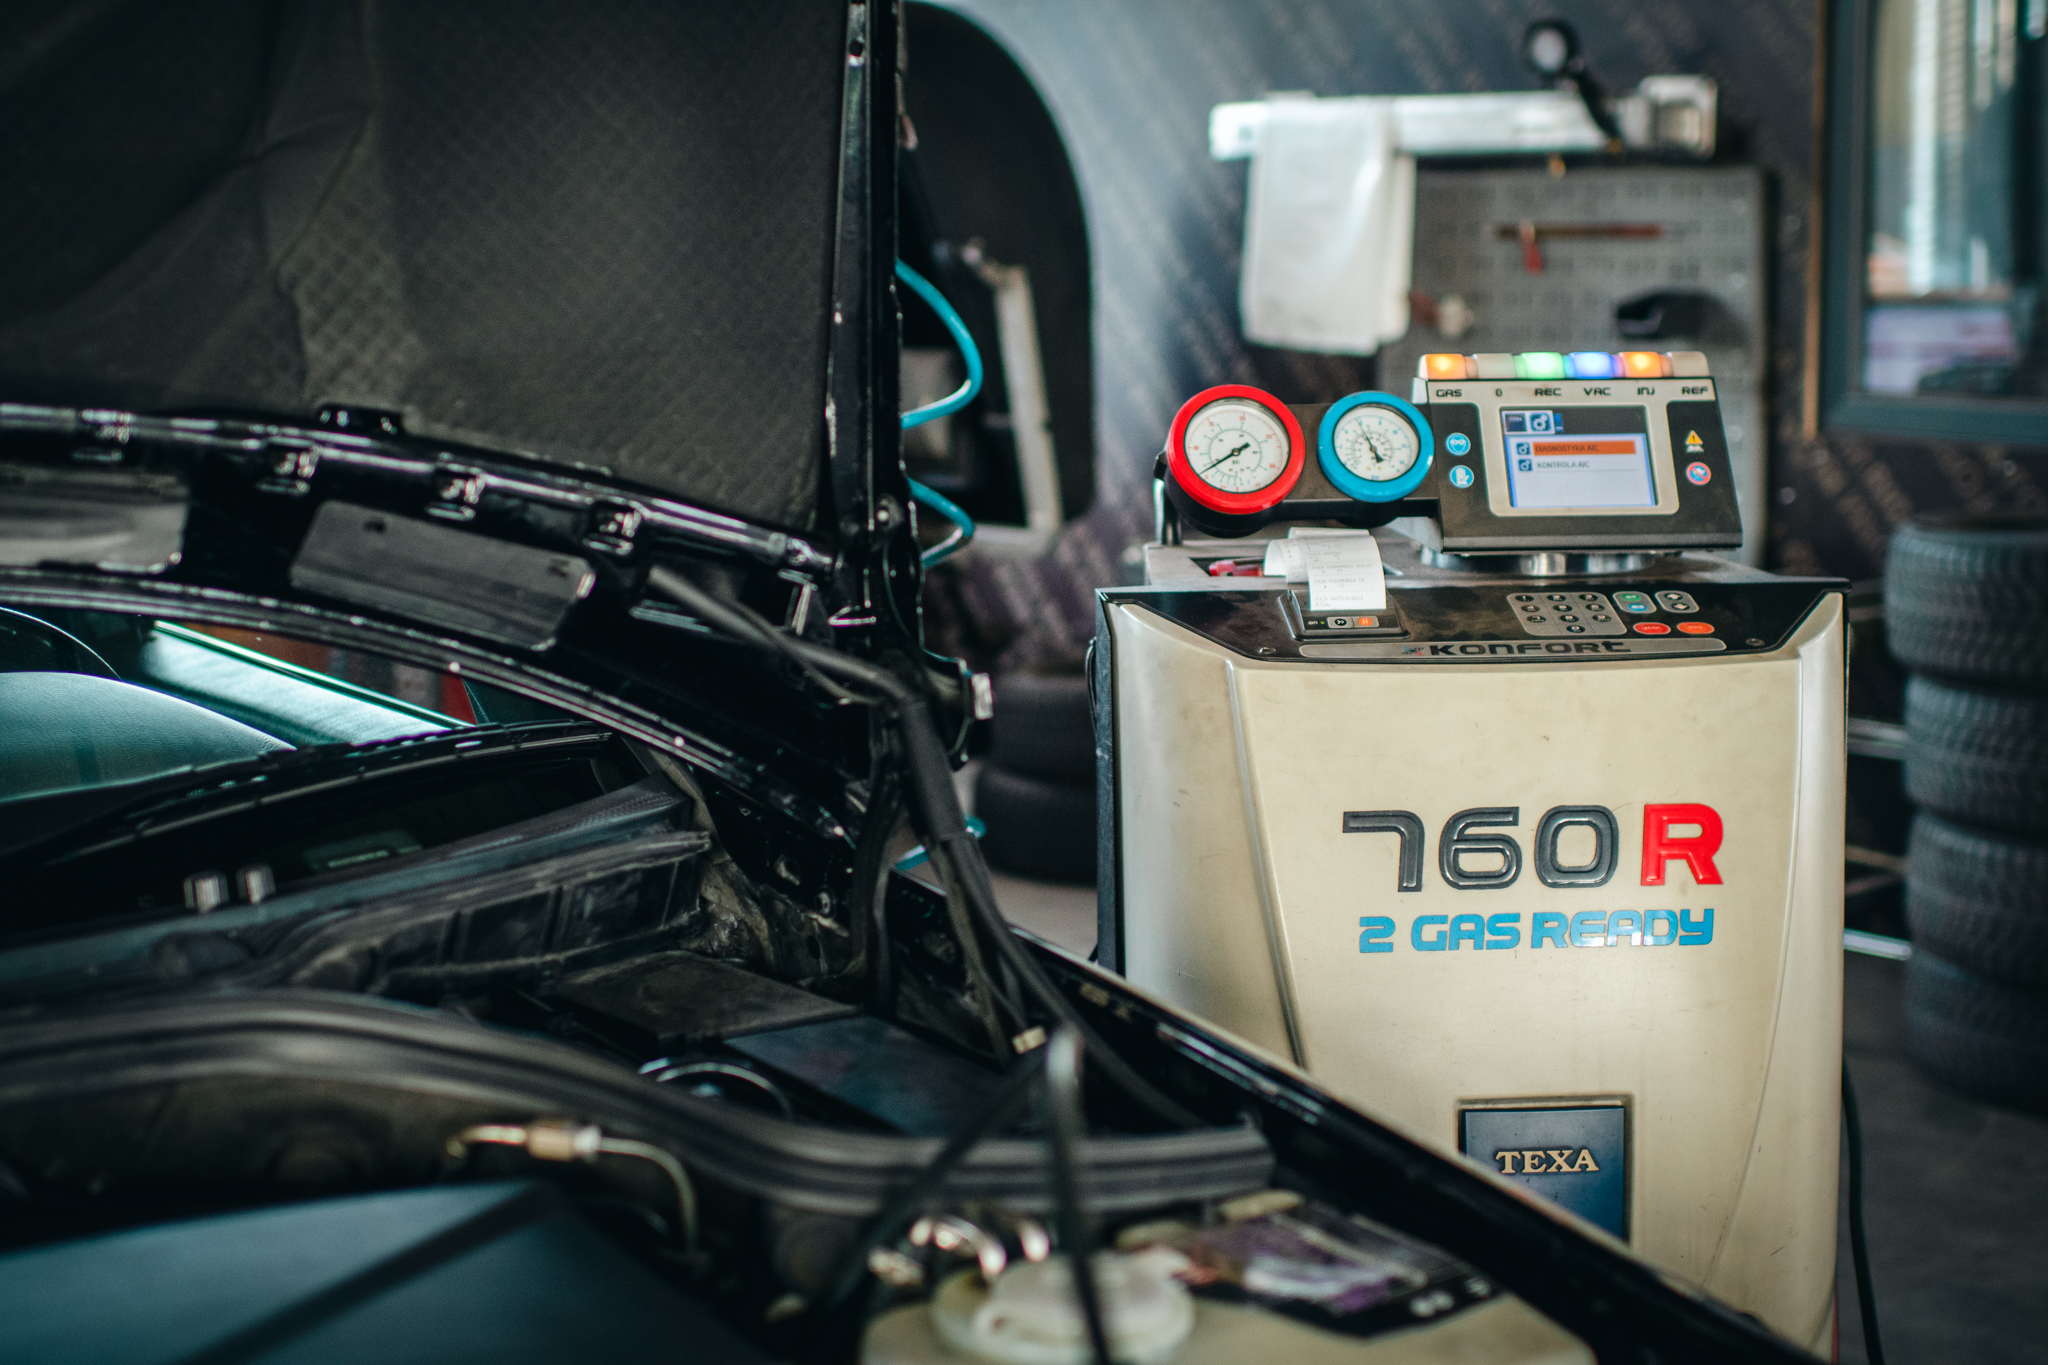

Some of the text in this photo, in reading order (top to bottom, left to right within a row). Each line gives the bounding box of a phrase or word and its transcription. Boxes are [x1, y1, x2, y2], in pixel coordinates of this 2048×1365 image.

[1436, 389, 1462, 398] GAS
[1534, 387, 1562, 397] REC
[1583, 387, 1612, 396] VAC
[1637, 386, 1655, 396] INJ
[1681, 386, 1709, 395] REF
[1535, 444, 1586, 453] DIAGNOSTYKA
[1537, 461, 1577, 469] KONTROLA
[1429, 640, 1632, 656] KONFORT
[1359, 908, 1714, 953] 2 GAS READY
[1495, 1149, 1599, 1174] TEXA
